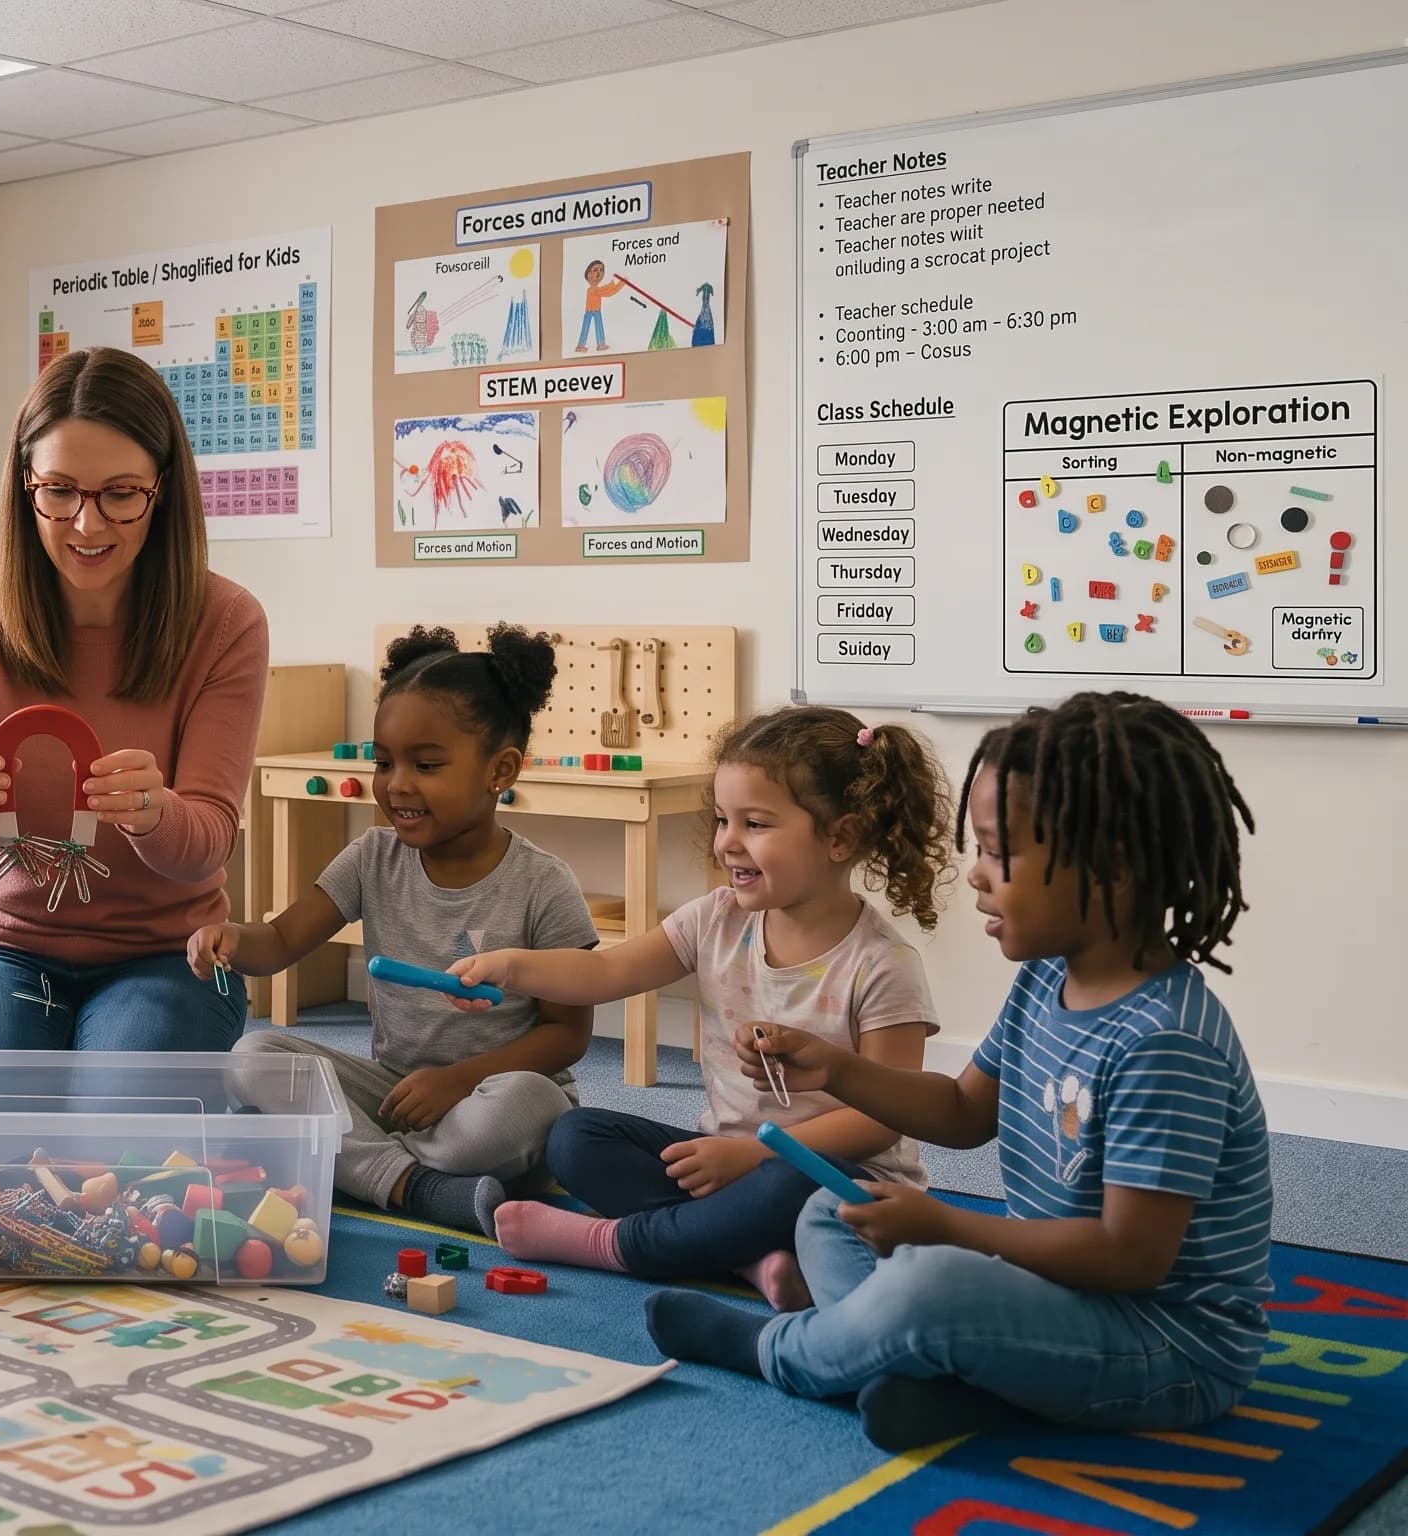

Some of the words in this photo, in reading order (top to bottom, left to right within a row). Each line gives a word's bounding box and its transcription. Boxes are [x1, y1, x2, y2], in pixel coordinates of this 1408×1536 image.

[816, 156, 887, 182] Teacher
[893, 151, 947, 172] Notes
[835, 190, 896, 211] Teacher
[901, 183, 946, 202] notes
[951, 178, 993, 196] write
[462, 208, 525, 235] Forces
[531, 203, 567, 228] and
[572, 195, 642, 221] Motion
[835, 213, 896, 233] Teacher
[901, 208, 925, 225] are
[930, 202, 983, 227] proper
[988, 192, 1045, 215] neeted
[612, 236, 653, 252] Forces
[658, 232, 680, 248] and
[835, 234, 896, 255] Teacher
[901, 230, 945, 249] notes
[624, 250, 667, 267] Motion
[835, 256, 905, 277] oniluding
[910, 257, 920, 270] a
[924, 247, 986, 268] scrocat
[991, 239, 1051, 265] project
[52, 272, 108, 296] Periodic
[112, 267, 149, 288] Table
[152, 264, 158, 286] /
[161, 254, 233, 282] Shaglified
[238, 252, 261, 271] for
[266, 246, 301, 268] Kids
[835, 301, 896, 321] Teacher
[901, 294, 973, 315] schedule
[836, 323, 905, 344] Coonting
[922, 318, 958, 337] 3:00
[962, 317, 987, 333] am
[1007, 310, 1044, 329] 6:30
[1050, 311, 1077, 330] pm
[836, 348, 870, 367] 6:00
[875, 348, 900, 368] pm
[921, 341, 972, 360] Cosus
[486, 376, 537, 398] STEM
[817, 403, 864, 422] Class
[869, 396, 954, 419] Schedule
[1024, 405, 1159, 441] Magnetic
[1169, 396, 1350, 433] Exploration
[835, 450, 896, 468] Monday
[1062, 455, 1117, 471] Sorting
[1215, 445, 1337, 465] Non-magnetic
[833, 488, 897, 506] Tuesday
[417, 541, 453, 554] Forces
[455, 541, 474, 553] and
[476, 539, 512, 553] Motion
[588, 538, 628, 551] Forces
[632, 537, 653, 550] and
[656, 536, 699, 549] Motion
[822, 526, 910, 545] Wednesday
[830, 564, 902, 583] Thursday
[1281, 612, 1352, 629] Magnetic
